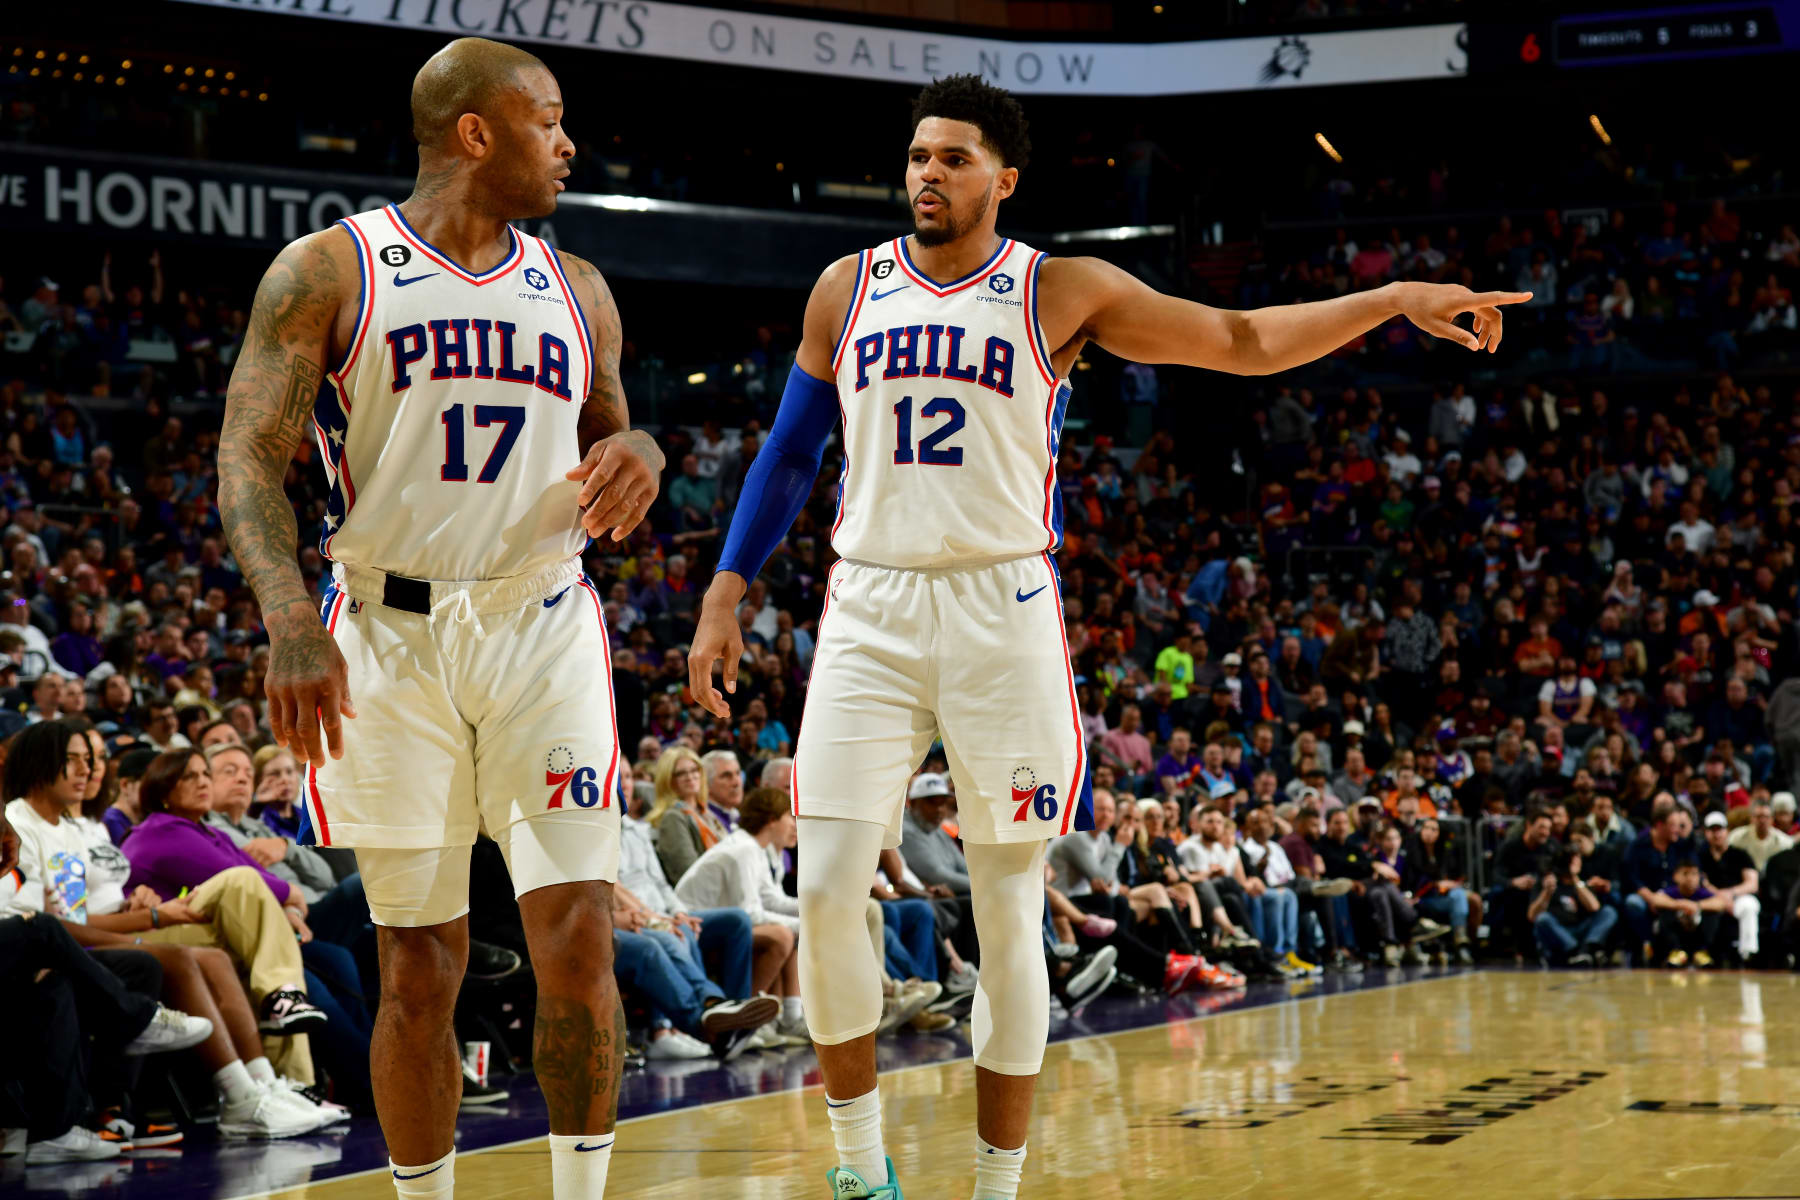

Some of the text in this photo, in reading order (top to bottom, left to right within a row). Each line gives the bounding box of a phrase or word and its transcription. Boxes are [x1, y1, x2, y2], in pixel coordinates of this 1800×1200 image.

[1521, 33, 1541, 62] 6
[1744, 20, 1757, 38] 3
[708, 19, 775, 56] ON
[813, 31, 942, 75] SALE
[979, 50, 1094, 85] NOW
[45, 166, 390, 240] HORNITO
[386, 247, 404, 264] 6
[876, 261, 892, 278] 6
[518, 292, 565, 306] crypto.com
[976, 295, 1022, 307] crypto.com
[385, 318, 572, 402] PHILA
[854, 324, 1015, 399] PHILA
[440, 402, 526, 484] 17
[893, 395, 966, 467] 12
[545, 766, 600, 810] 76
[1011, 783, 1059, 822] 76
